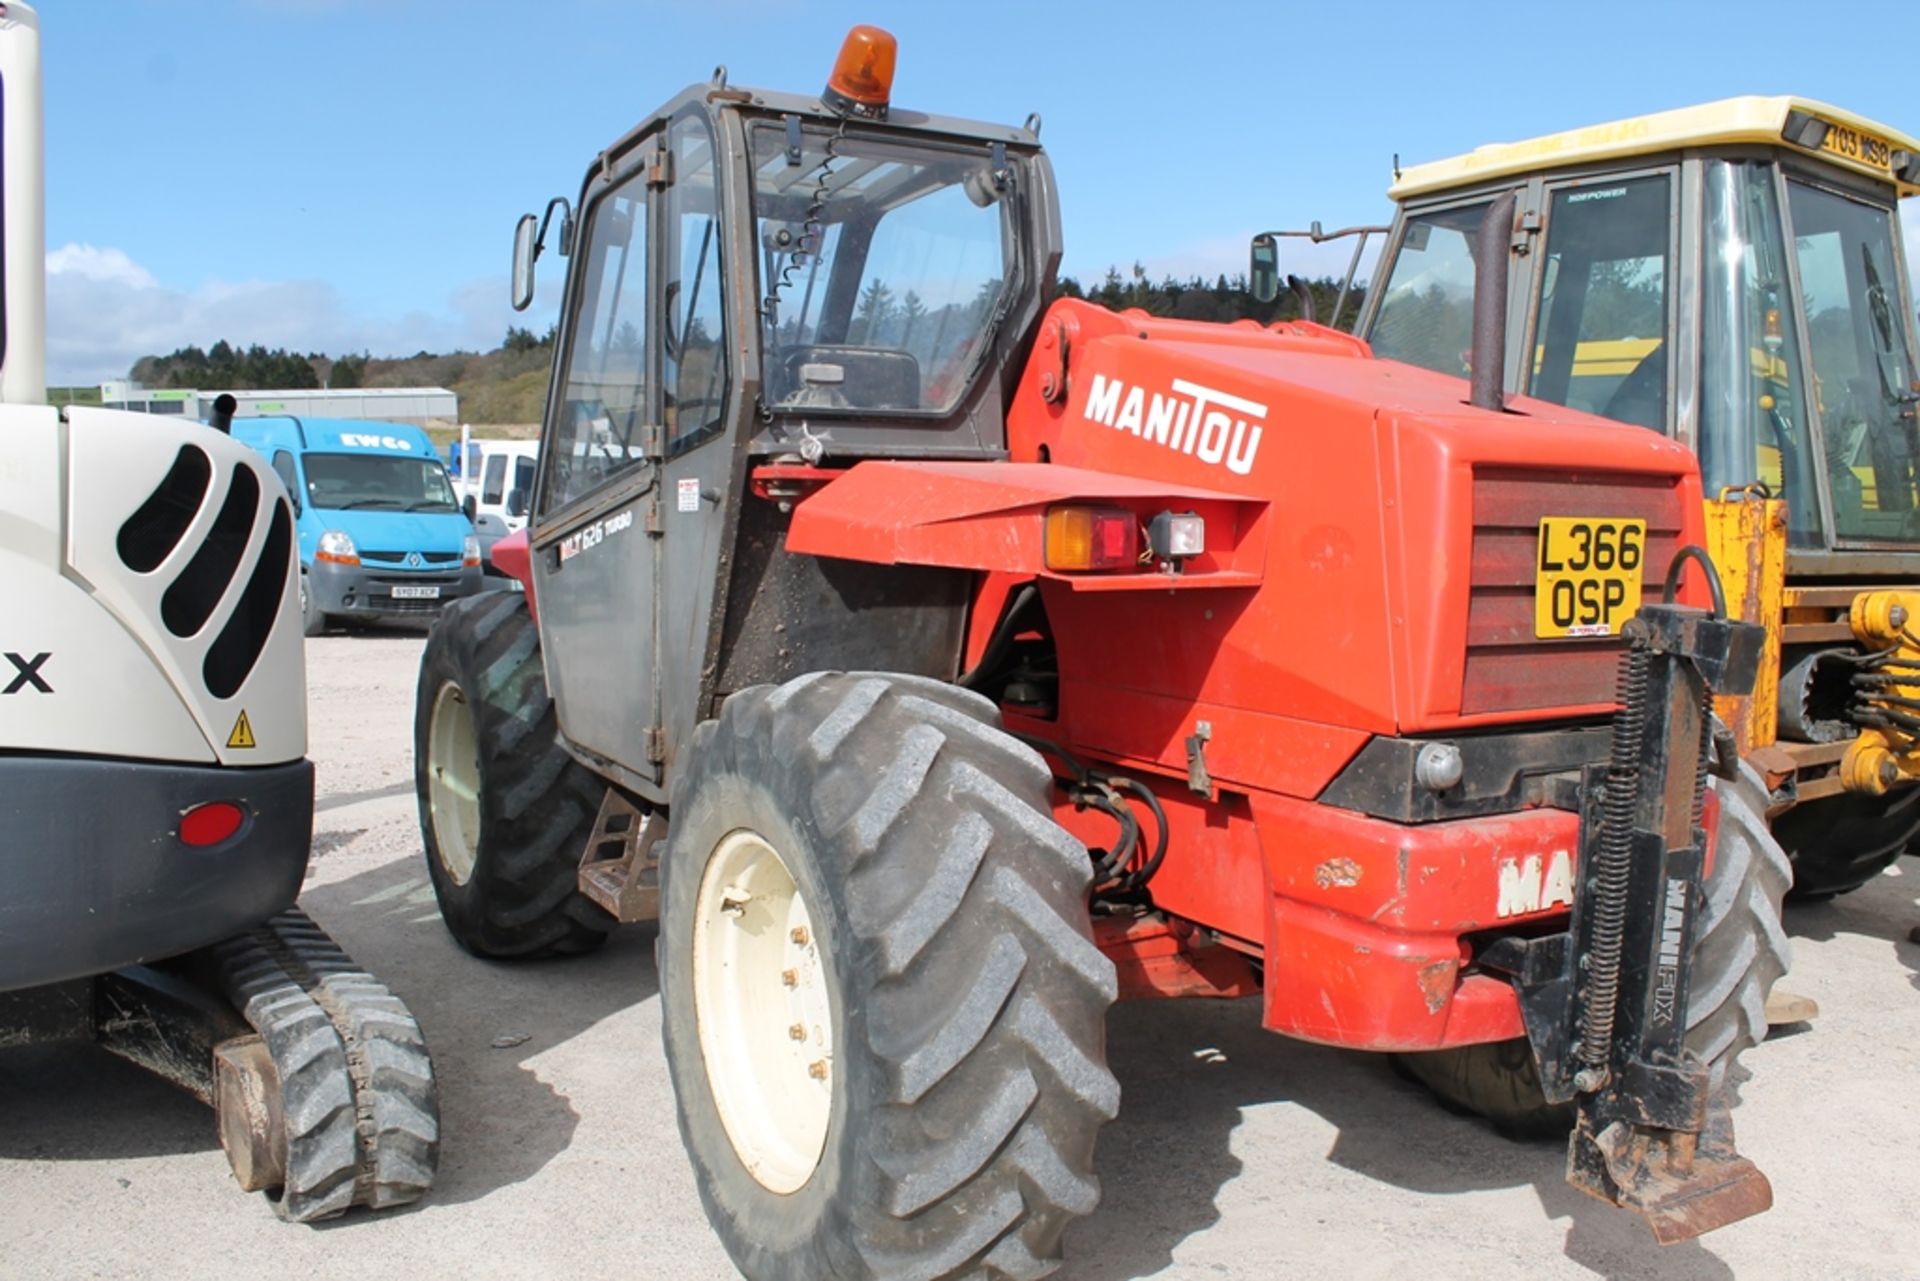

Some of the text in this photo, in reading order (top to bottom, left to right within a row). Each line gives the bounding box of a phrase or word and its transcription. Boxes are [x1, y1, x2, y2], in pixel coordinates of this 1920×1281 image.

[1084, 374, 1268, 475] MANITOU
[583, 520, 603, 550] 626
[1541, 523, 1641, 571] L366
[1552, 578, 1625, 628] OSP
[1, 652, 55, 694] X
[1497, 850, 1574, 918] MA
[1653, 879, 1688, 1022] MANIFIX
